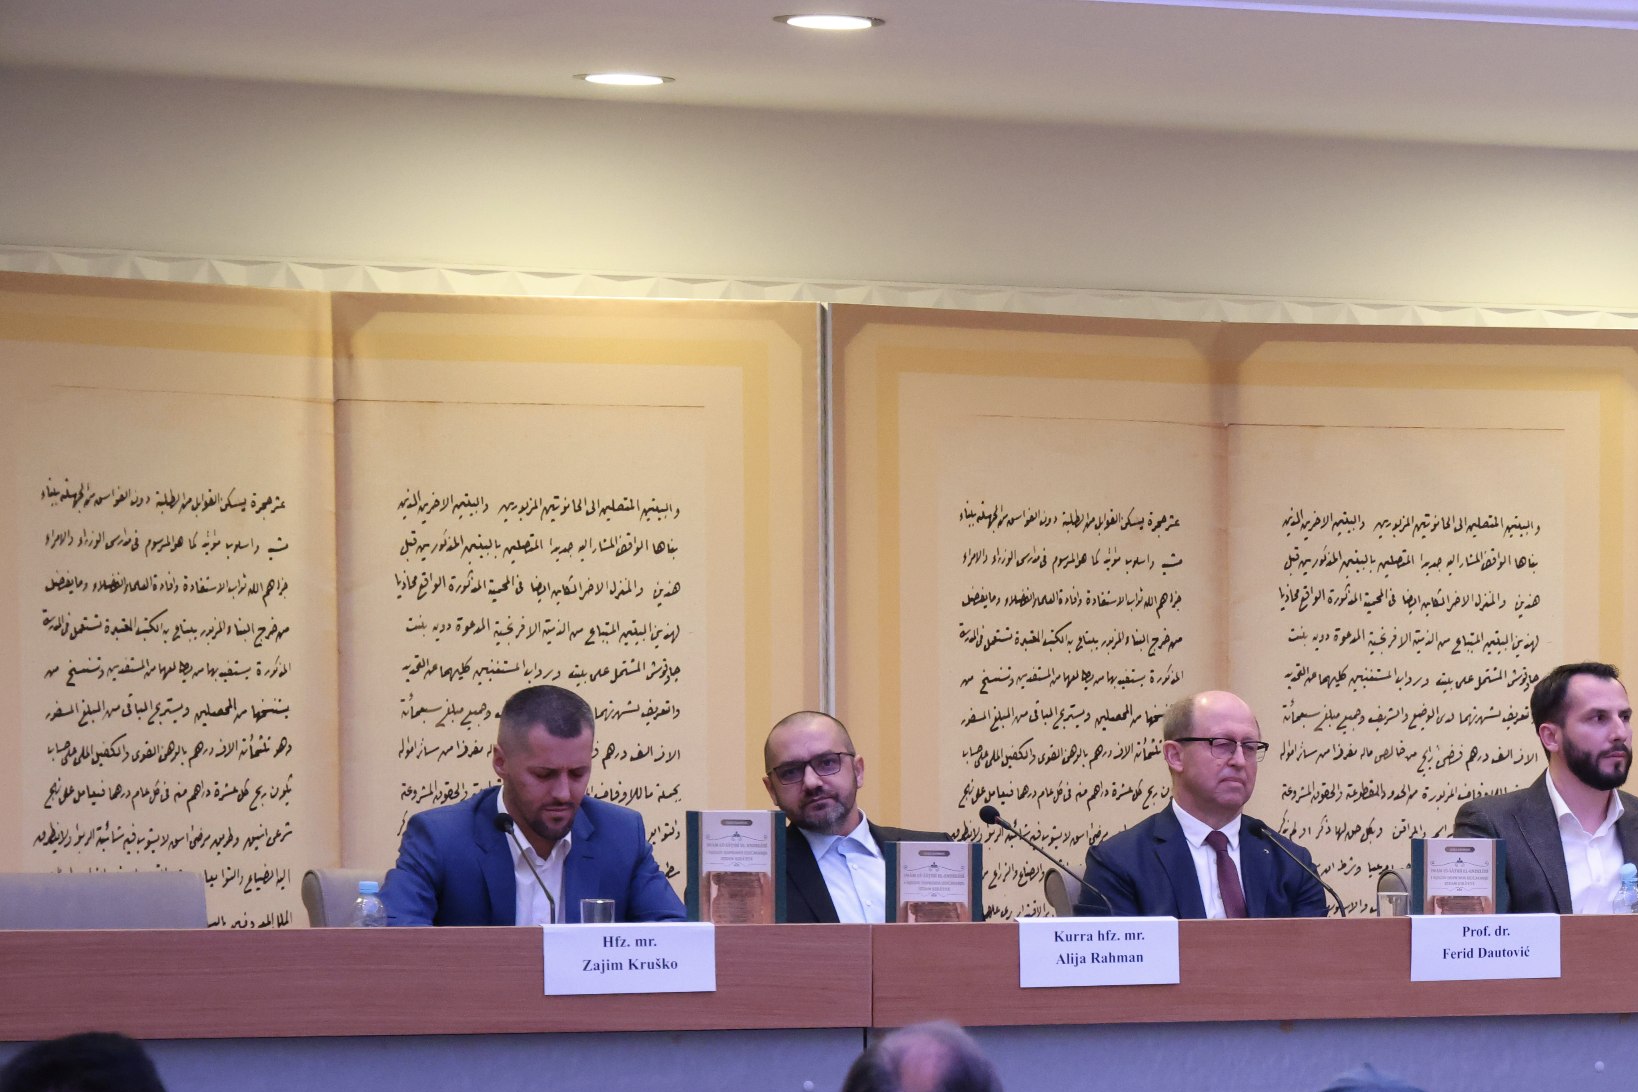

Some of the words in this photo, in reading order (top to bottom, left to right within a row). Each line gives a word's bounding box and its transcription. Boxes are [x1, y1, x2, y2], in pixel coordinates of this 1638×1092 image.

[1054, 930, 1093, 943] Kurra
[1097, 929, 1120, 942] hfz.
[1124, 931, 1145, 941] mr.
[1462, 925, 1491, 937] Prof.
[1494, 925, 1511, 937] dr.
[602, 935, 631, 948] Hfz.
[635, 937, 657, 947] mr.
[1442, 947, 1474, 960] Ferid
[1477, 945, 1531, 959] Dautović
[582, 958, 623, 974] Zajim
[628, 957, 679, 971] Kruško
[1055, 952, 1086, 968] Alija
[1090, 952, 1144, 964] Rahman
